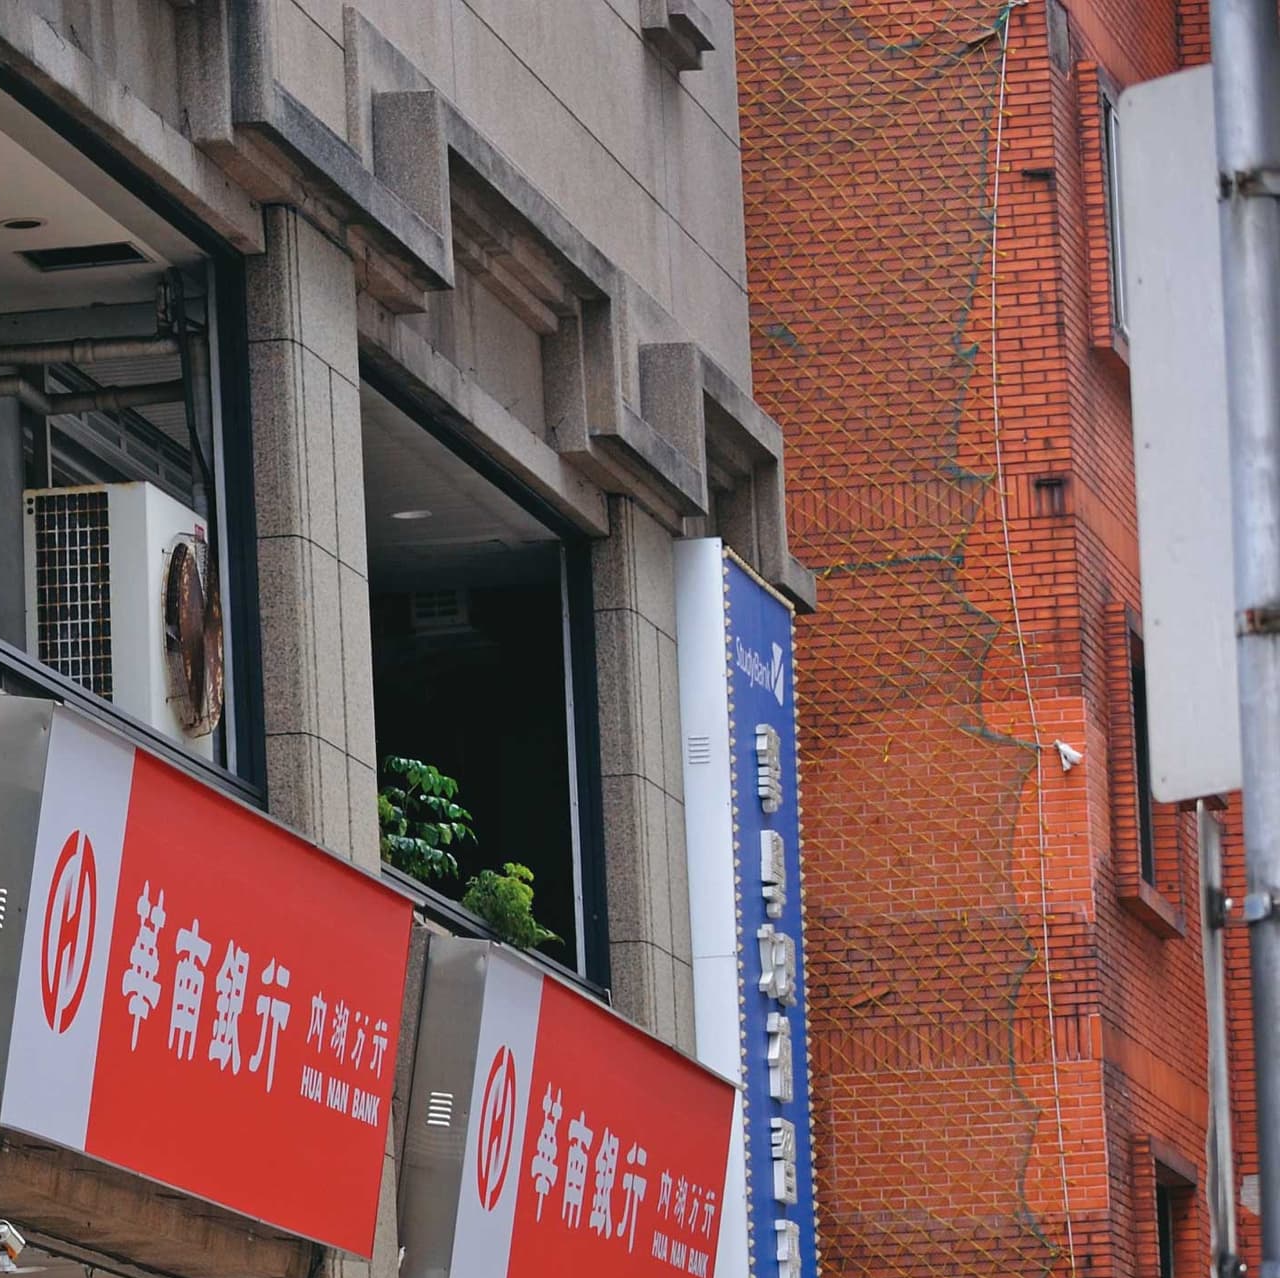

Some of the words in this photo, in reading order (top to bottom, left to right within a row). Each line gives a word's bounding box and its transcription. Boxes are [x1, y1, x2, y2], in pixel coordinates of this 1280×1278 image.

[734, 635, 772, 694] StudyBank
[121, 879, 292, 1094] 華南銀行
[305, 989, 389, 1081] 內湖分行
[300, 1064, 324, 1105] HUA
[326, 1074, 349, 1116] NAN
[351, 1085, 380, 1129] BANK
[529, 1081, 648, 1256] 華南銀行
[651, 1229, 668, 1263] HUA
[670, 1236, 687, 1271] NAN
